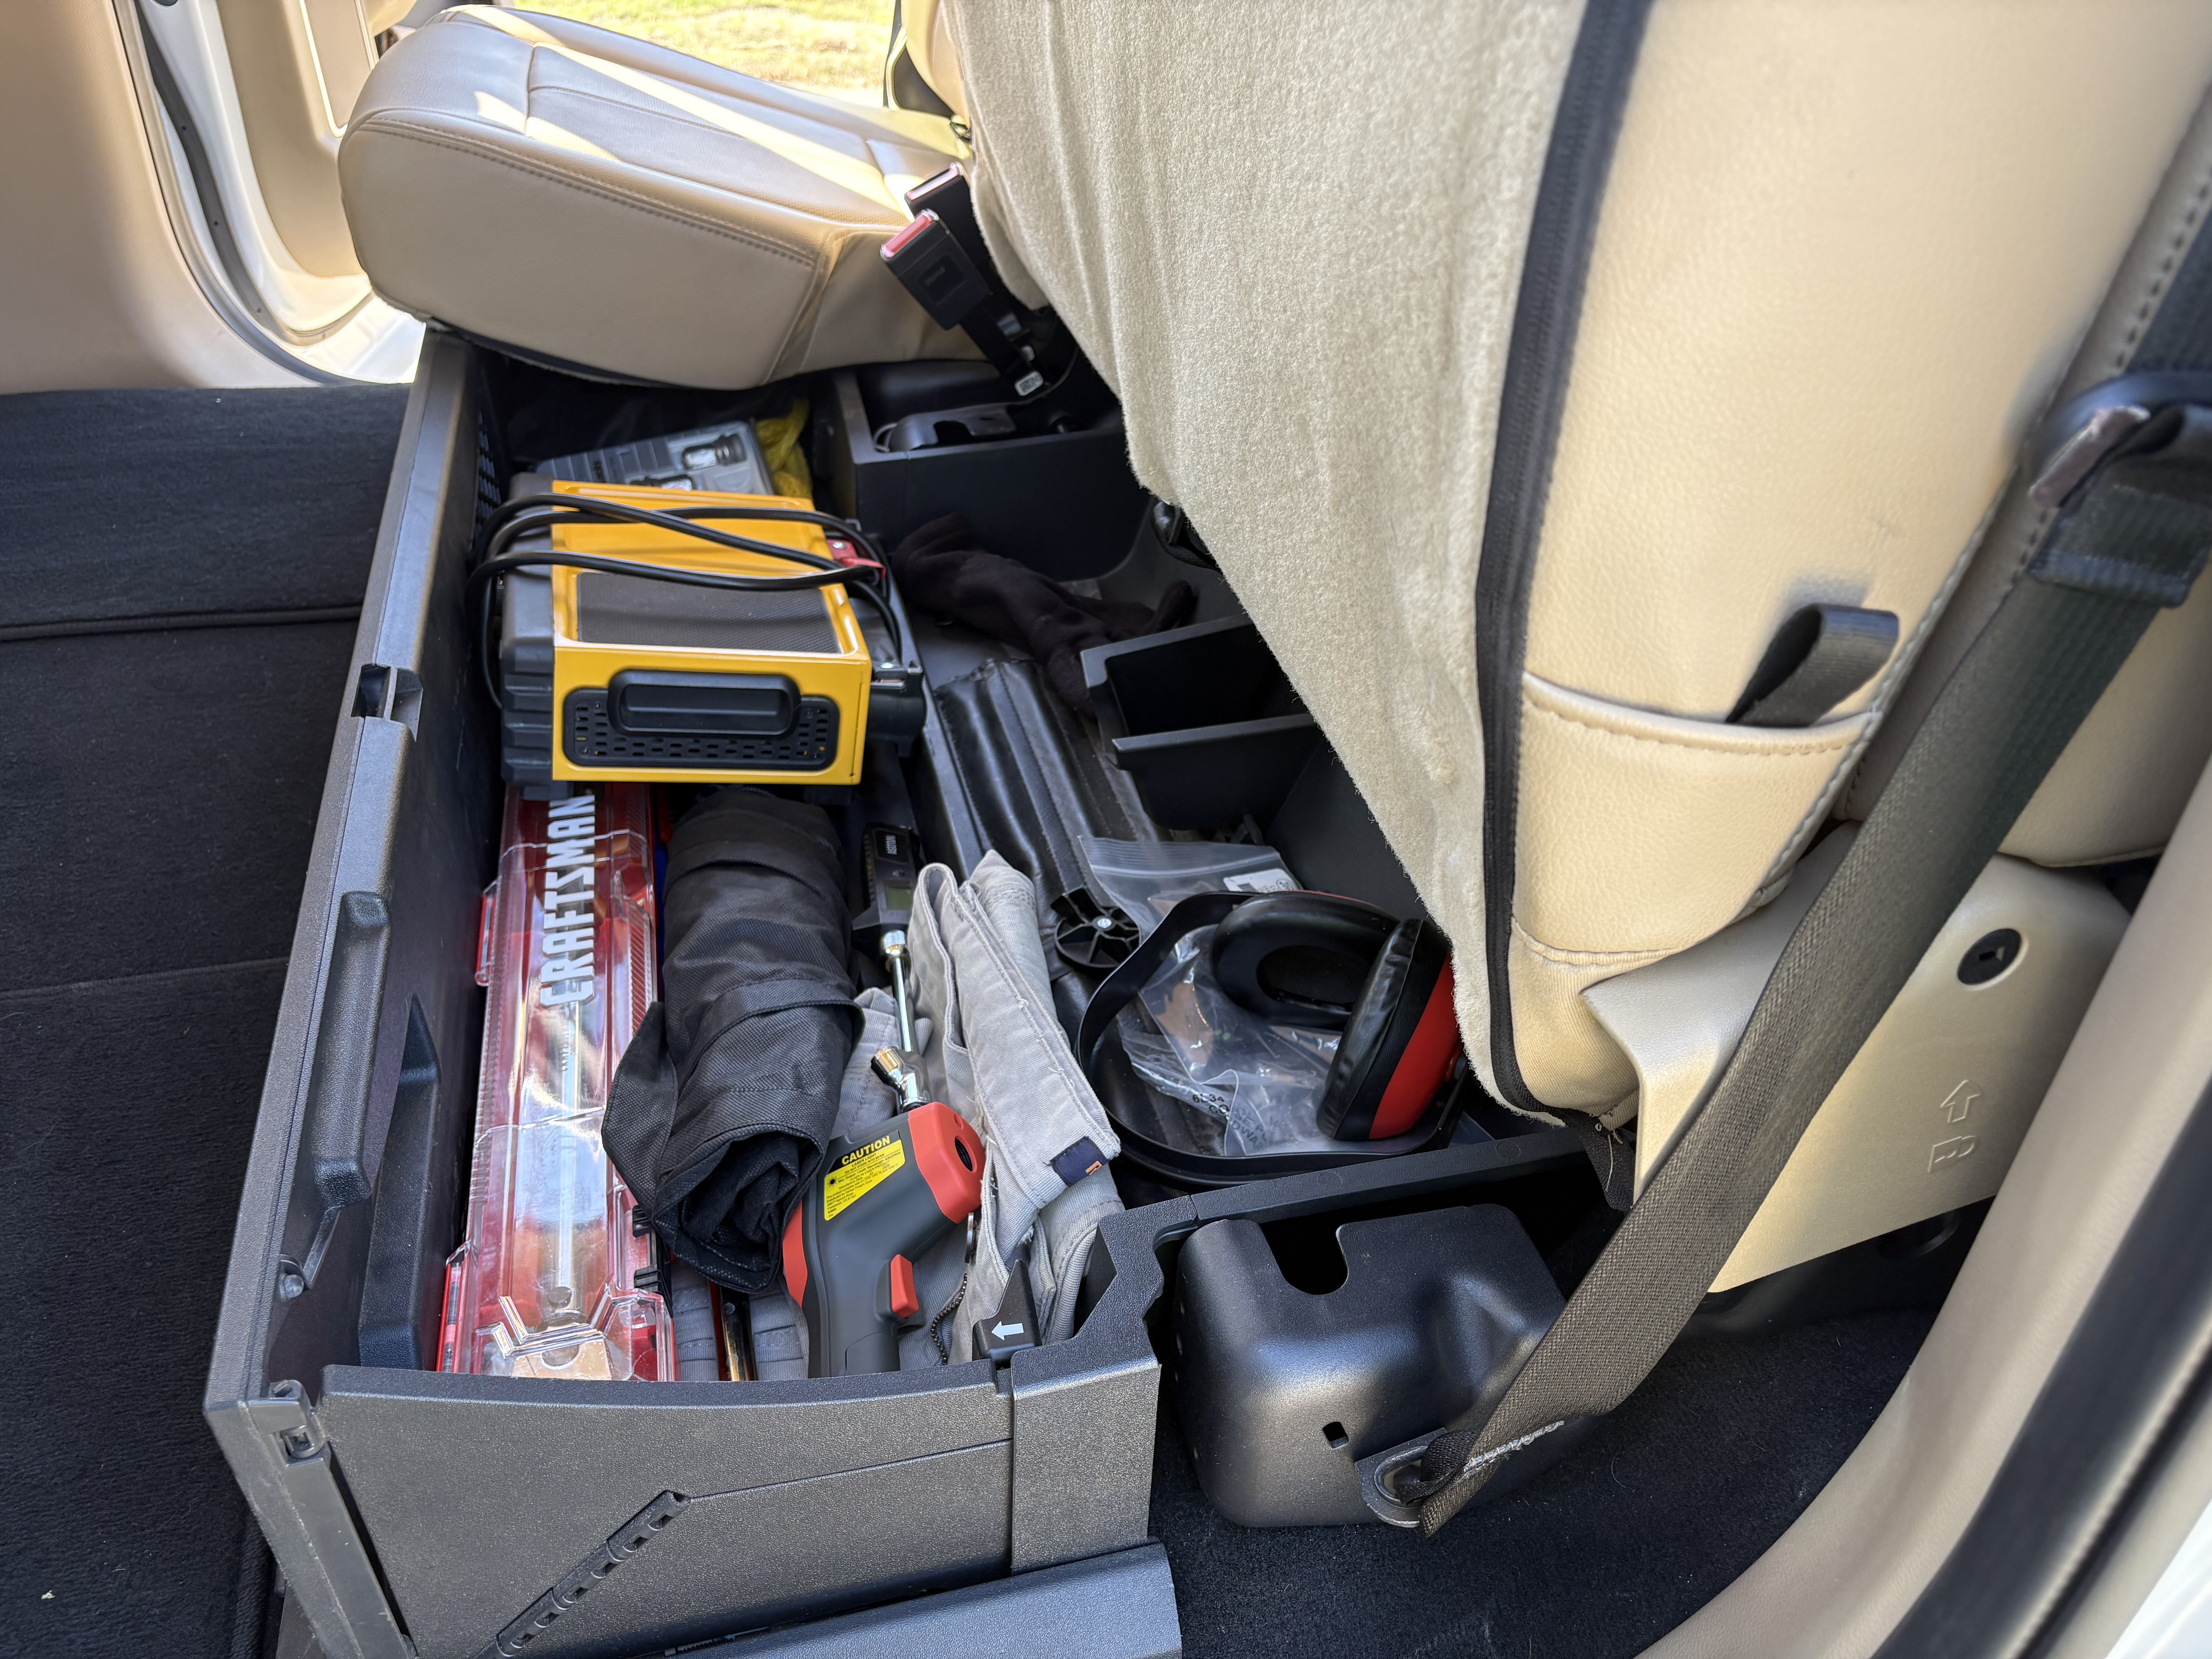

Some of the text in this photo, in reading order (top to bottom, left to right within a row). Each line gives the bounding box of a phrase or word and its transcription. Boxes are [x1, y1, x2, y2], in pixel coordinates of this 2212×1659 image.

[540, 794, 595, 1006] CRAFTSMAN
[842, 1135, 890, 1165] CAUTION
[852, 1152, 876, 1167] LASER LIGHT
